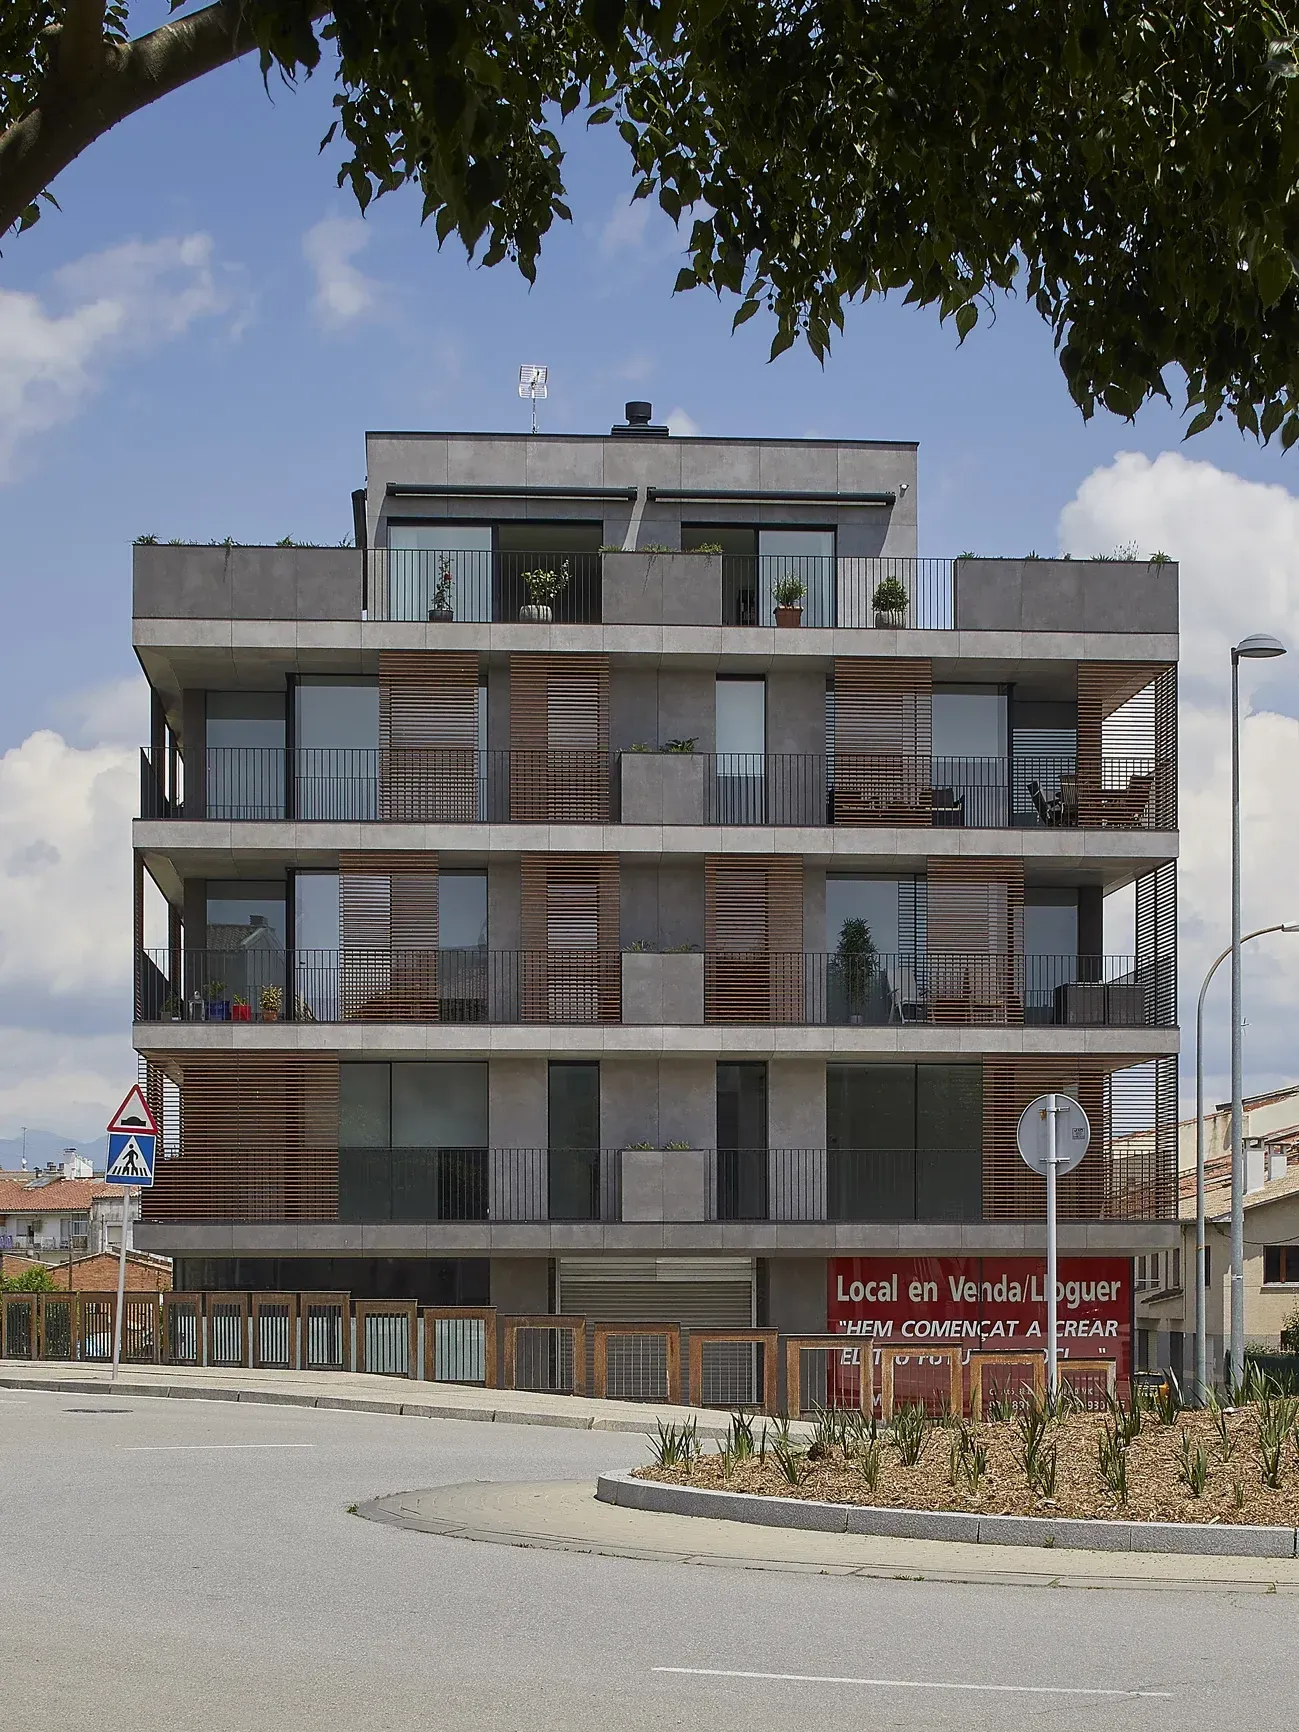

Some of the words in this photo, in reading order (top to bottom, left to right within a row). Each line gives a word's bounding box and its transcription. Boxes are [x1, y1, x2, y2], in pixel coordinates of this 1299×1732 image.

[837, 1273, 898, 1302] Local
[908, 1280, 938, 1302] en
[901, 1320, 1019, 1342] COMENÇAT
[1025, 1320, 1042, 1337] A
[1056, 1320, 1118, 1337] CREAR
